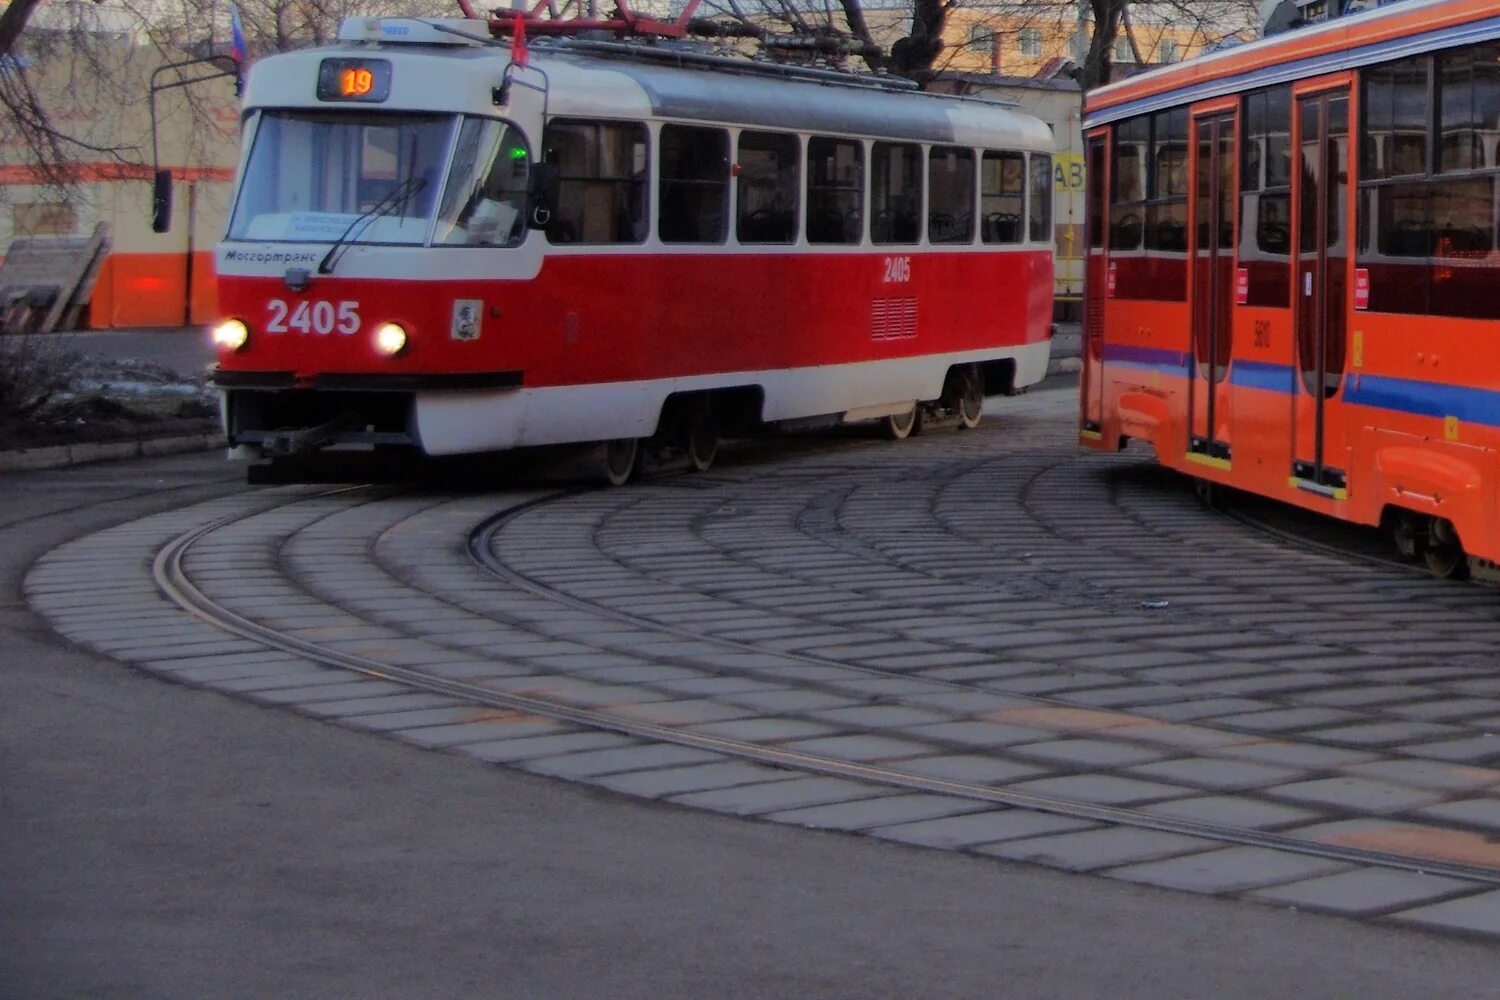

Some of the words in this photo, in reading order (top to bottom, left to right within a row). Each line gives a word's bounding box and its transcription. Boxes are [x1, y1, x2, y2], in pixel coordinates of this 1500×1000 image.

[342, 68, 373, 96] 19
[224, 251, 317, 265] Мосгортранс
[884, 256, 911, 283] 2405
[266, 299, 361, 335] 2405
